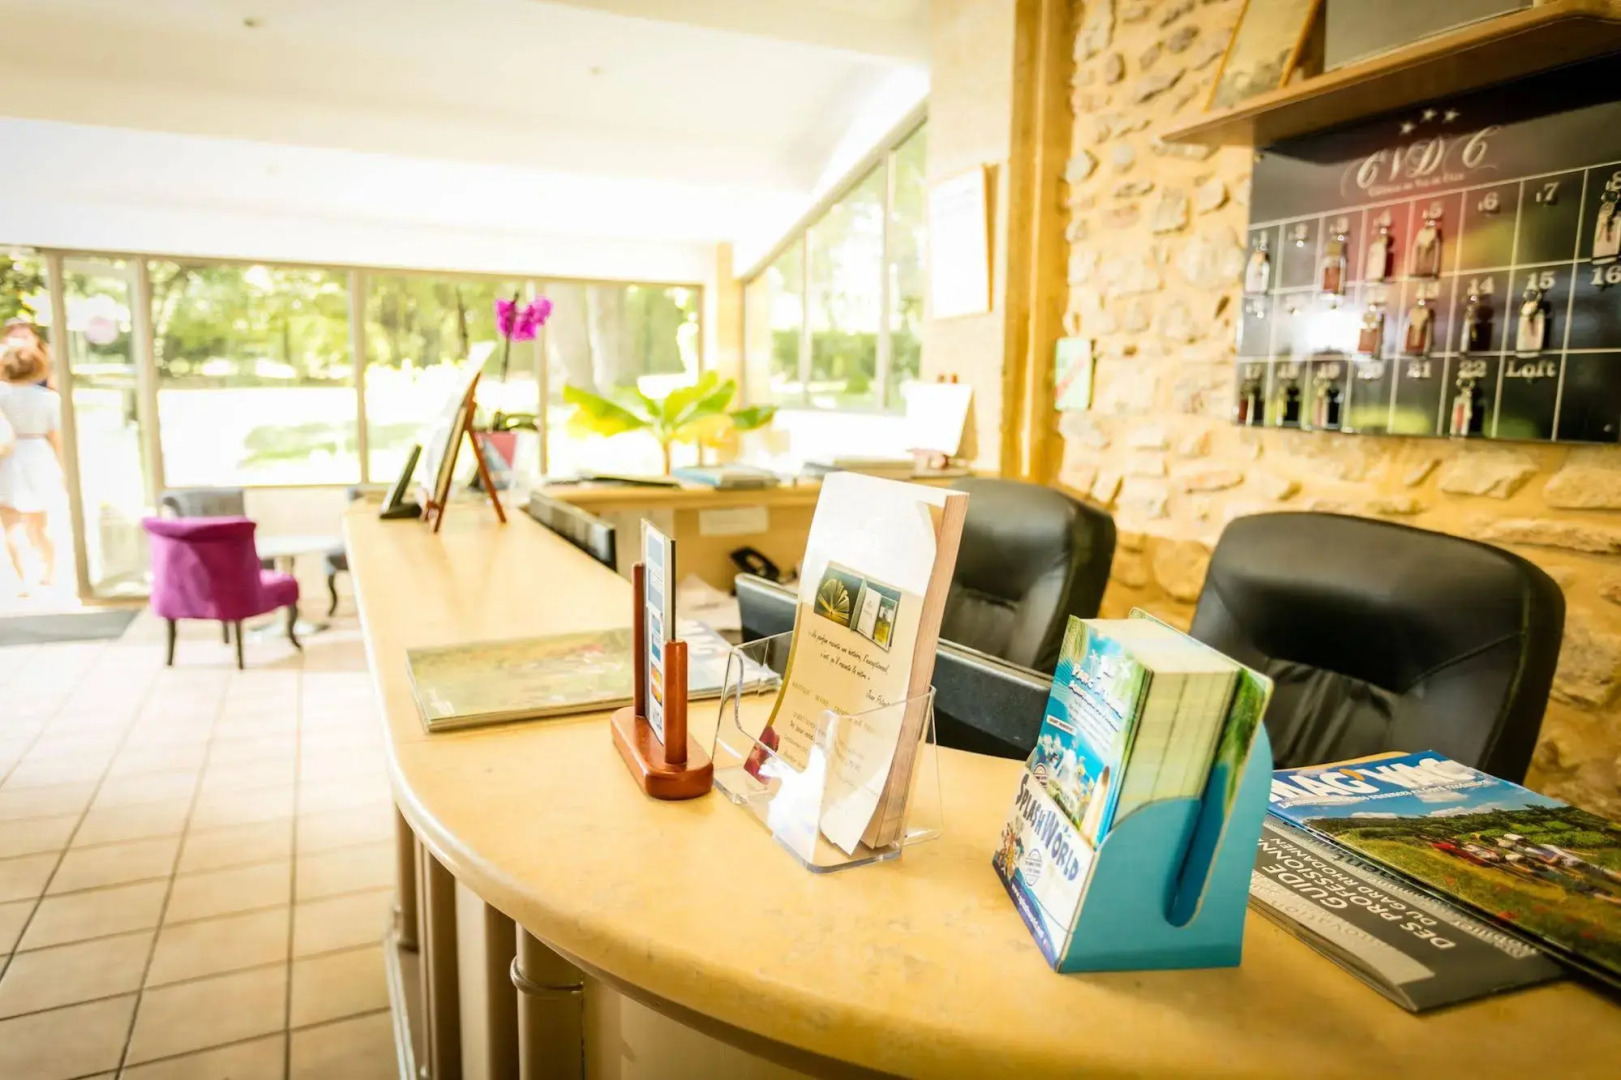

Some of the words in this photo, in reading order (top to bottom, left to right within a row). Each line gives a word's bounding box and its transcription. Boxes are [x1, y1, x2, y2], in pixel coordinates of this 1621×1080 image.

[1483, 191, 1499, 210] 6
[1542, 182, 1560, 201] 7
[1525, 270, 1556, 291] 15
[1590, 264, 1621, 285] 16
[1457, 360, 1487, 378] 22
[1504, 359, 1557, 378] Loft
[1269, 837, 1359, 886] RHODANIEN
[1257, 838, 1403, 921] PROFESSIONN
[1261, 863, 1349, 909] GUIDE
[1357, 886, 1407, 910] GARD
[1405, 910, 1438, 926] DU
[1399, 921, 1457, 949] DES
